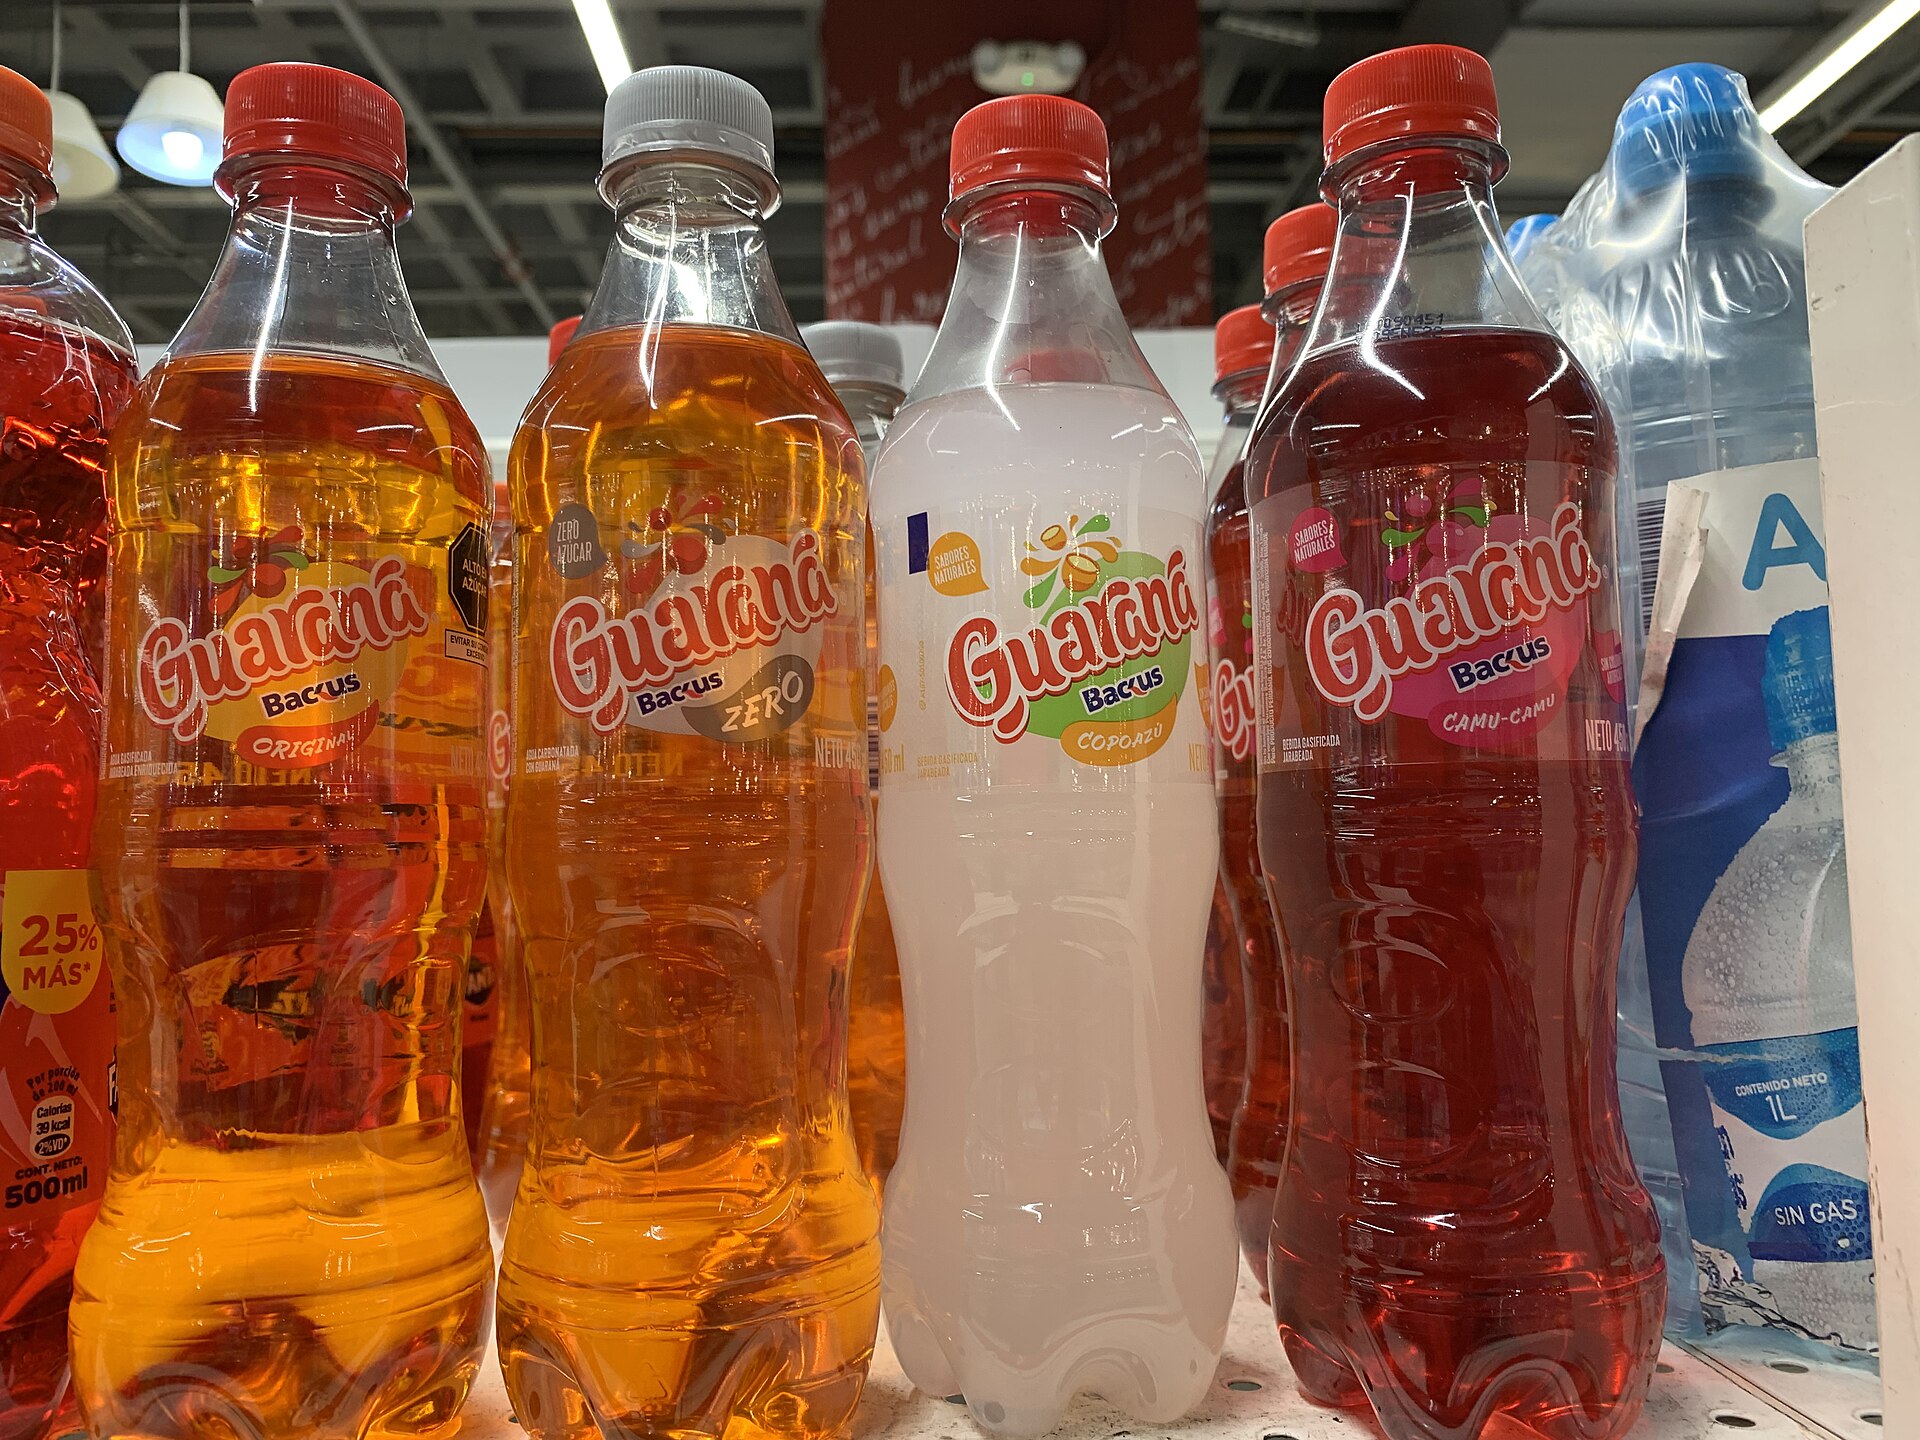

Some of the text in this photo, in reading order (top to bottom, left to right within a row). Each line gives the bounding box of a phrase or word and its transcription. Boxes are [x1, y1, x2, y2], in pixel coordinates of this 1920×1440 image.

[556, 517, 580, 542] ZERO
[1294, 520, 1329, 549] SABORES
[556, 540, 593, 566] AZÚCAR
[934, 545, 970, 569] SABORES
[1294, 537, 1336, 562] NATURALES
[462, 558, 481, 576] ALTO
[934, 562, 977, 586] NATURALES
[462, 577, 488, 599] AZÚCAR
[1305, 501, 1601, 725] Guaraná
[450, 635, 470, 647] EVITAR
[550, 527, 839, 737] Guaraná
[137, 556, 433, 747] Guaraná
[944, 545, 1199, 745] Guaraná
[1449, 635, 1552, 695] Backus
[262, 669, 362, 719] Backus
[635, 670, 725, 717] Backus
[720, 669, 805, 734] ZERO
[1080, 666, 1164, 715] Backus
[1442, 693, 1556, 732] CAMU-CAMU
[251, 730, 357, 761] ORIGINAL
[1077, 722, 1163, 752] COPOAZÚ
[1282, 734, 1341, 751] BEBIDA GASIFICADA
[1585, 719, 1612, 751] NETO
[121, 750, 152, 764] GASIFICADA
[538, 745, 579, 759] CARBONATADA
[814, 735, 843, 768] NETO
[894, 743, 905, 772] ml
[917, 752, 978, 767] BEBIDA GASIFICADA
[1282, 749, 1314, 763] JARABEADA
[134, 761, 178, 777] ENRIQUECIDA
[917, 766, 950, 779] JARABEADA
[19, 913, 98, 957] 25%
[27, 1066, 80, 1089] Por porción
[1736, 1072, 1828, 1097] CONTENIDO NETO
[32, 1080, 79, 1101] de 200 ml
[36, 1102, 72, 1119] Calorías
[1765, 1095, 1798, 1122] 1L
[36, 1116, 71, 1136] 39 kcal
[15, 1156, 83, 1180] CONT. NETO:
[1775, 1199, 1858, 1227] SIN GAS
